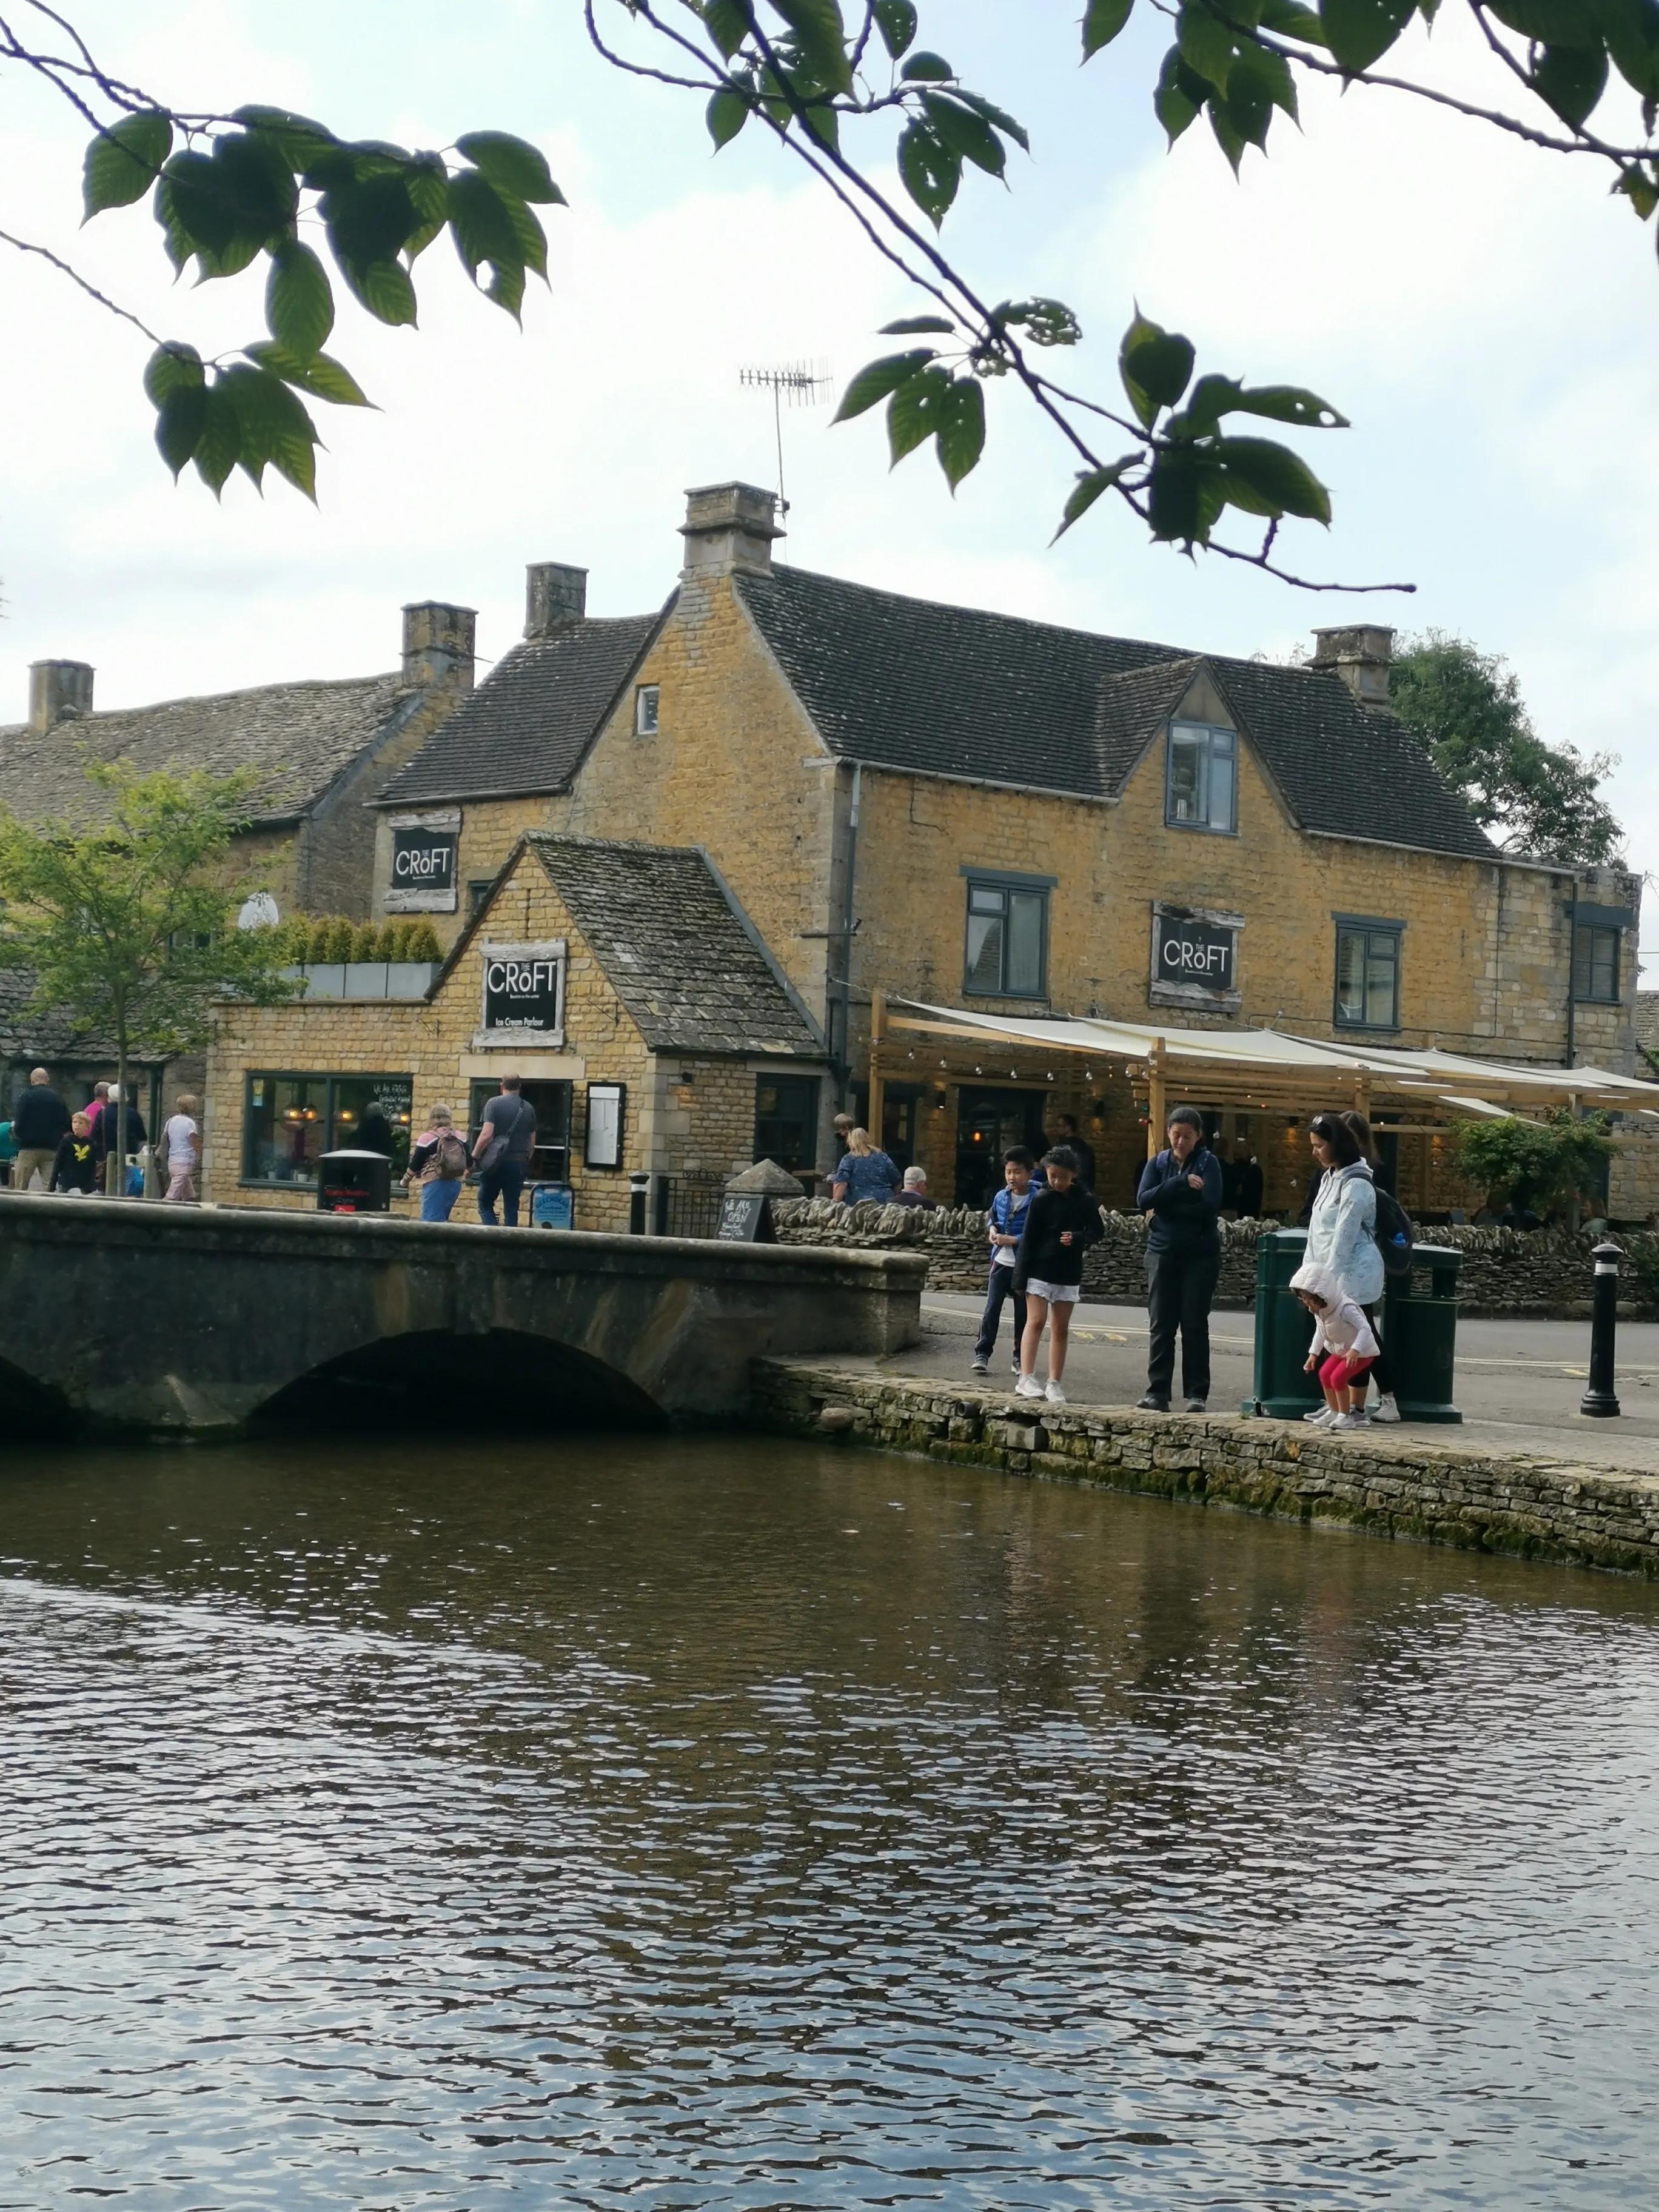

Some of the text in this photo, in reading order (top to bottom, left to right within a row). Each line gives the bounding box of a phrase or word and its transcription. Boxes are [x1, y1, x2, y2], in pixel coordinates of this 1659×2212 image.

[495, 1016, 544, 1026] Ice Cream Parlour
